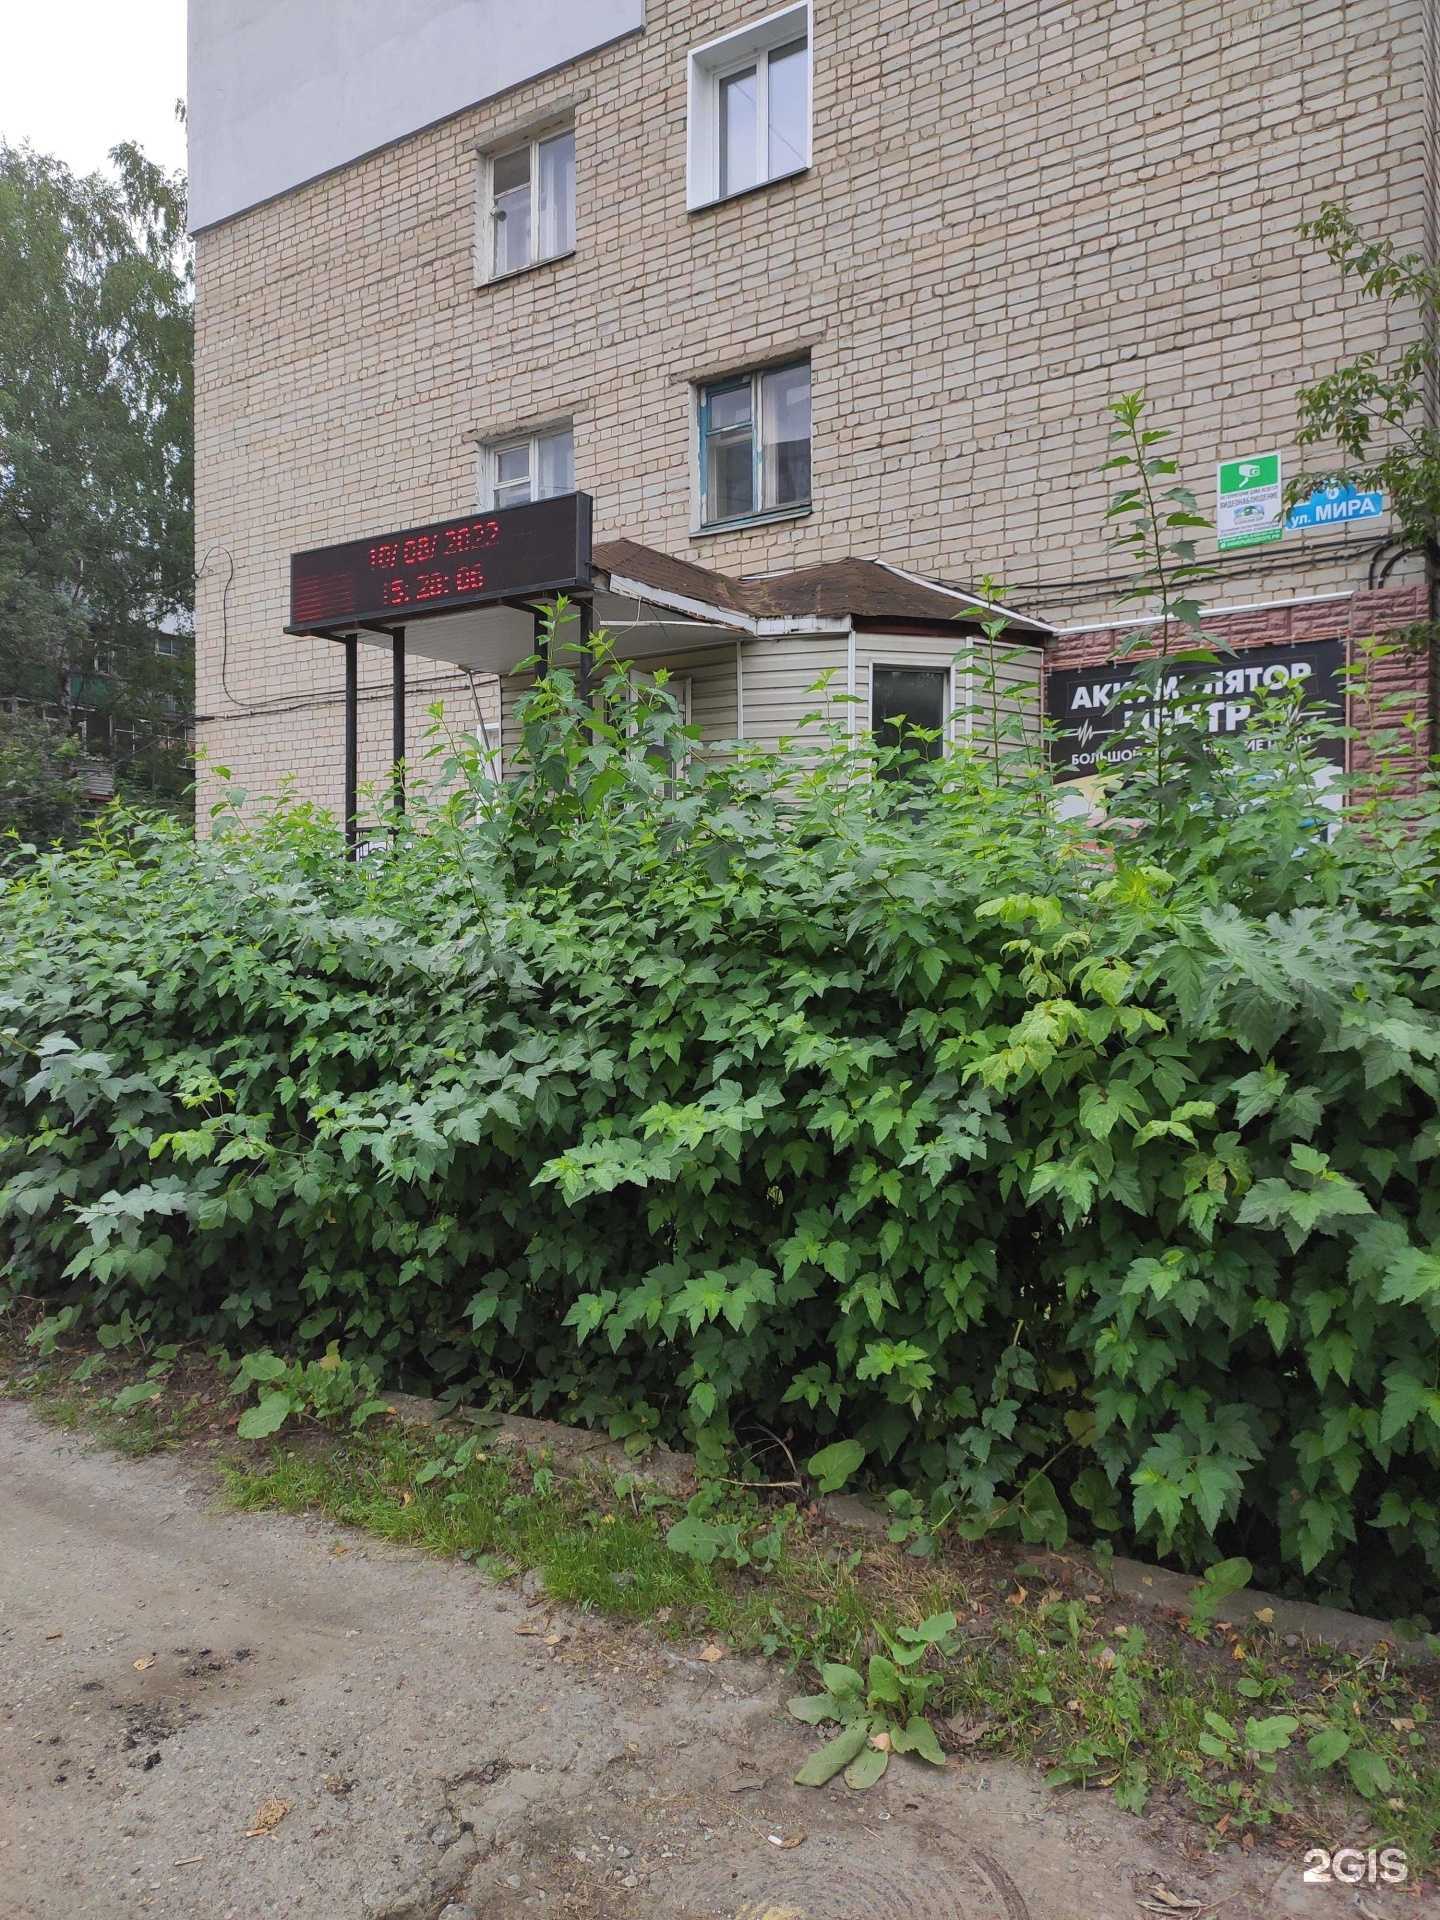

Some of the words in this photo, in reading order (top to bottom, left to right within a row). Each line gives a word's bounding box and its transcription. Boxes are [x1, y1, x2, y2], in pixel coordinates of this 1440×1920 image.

[1290, 513, 1311, 529] ул.
[1315, 497, 1376, 522] МИРА
[1071, 662, 1312, 710] АКМЛЯТОР
